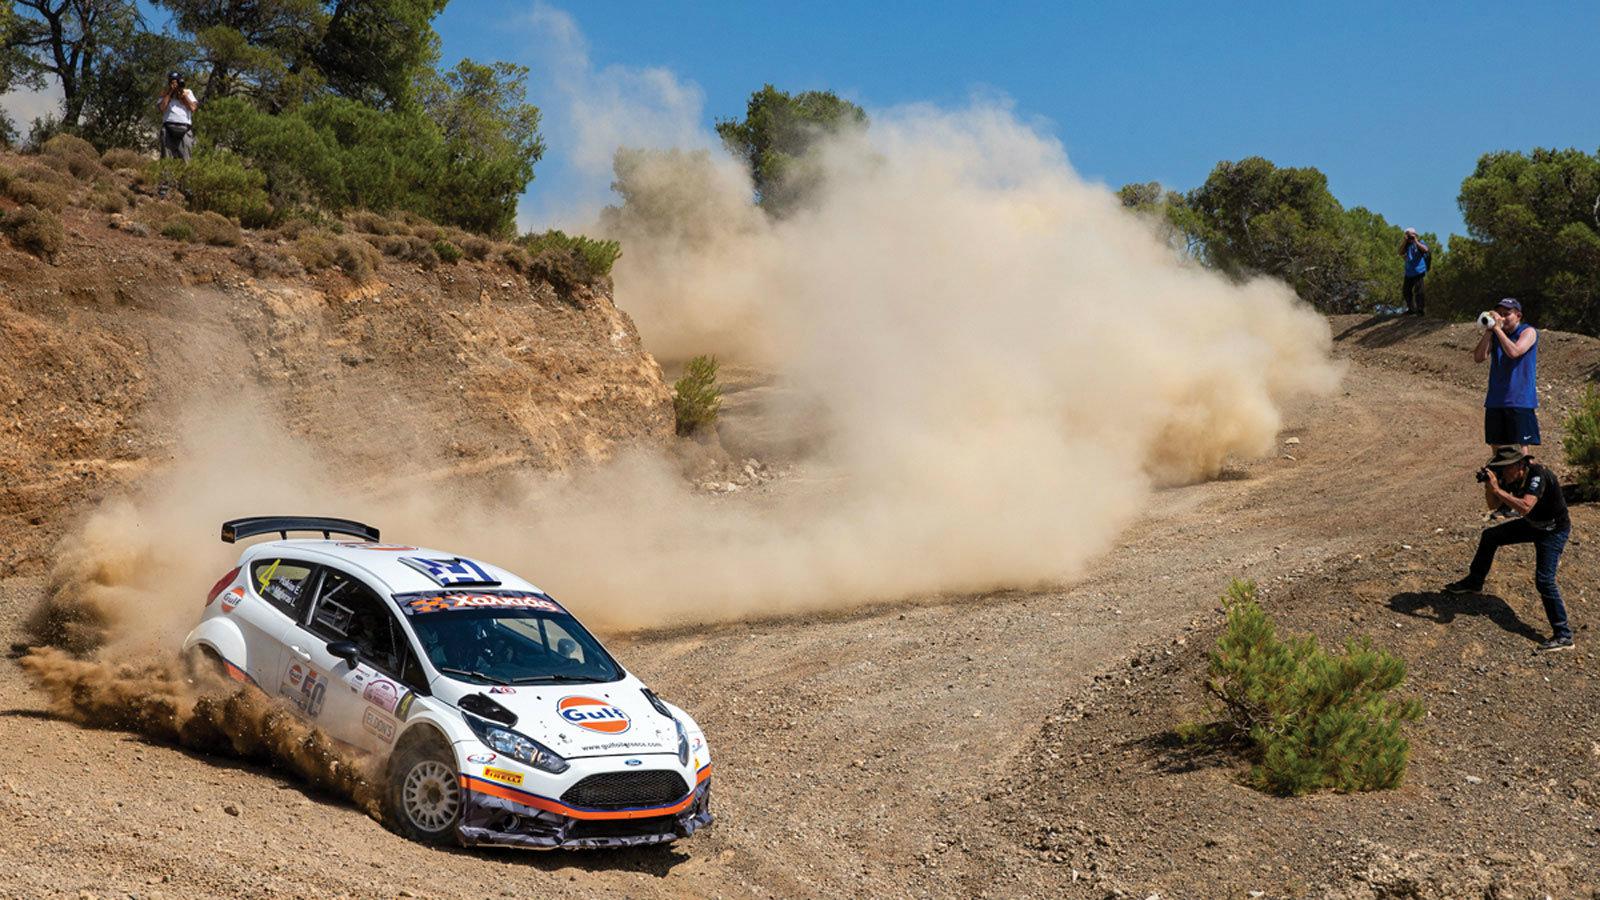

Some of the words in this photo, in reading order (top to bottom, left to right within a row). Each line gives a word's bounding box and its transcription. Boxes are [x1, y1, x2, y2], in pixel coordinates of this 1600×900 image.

[259, 559, 280, 596] 4
[223, 592, 242, 607] Gulf
[562, 707, 625, 722] Gulf
[484, 767, 523, 784] PIRELLI
